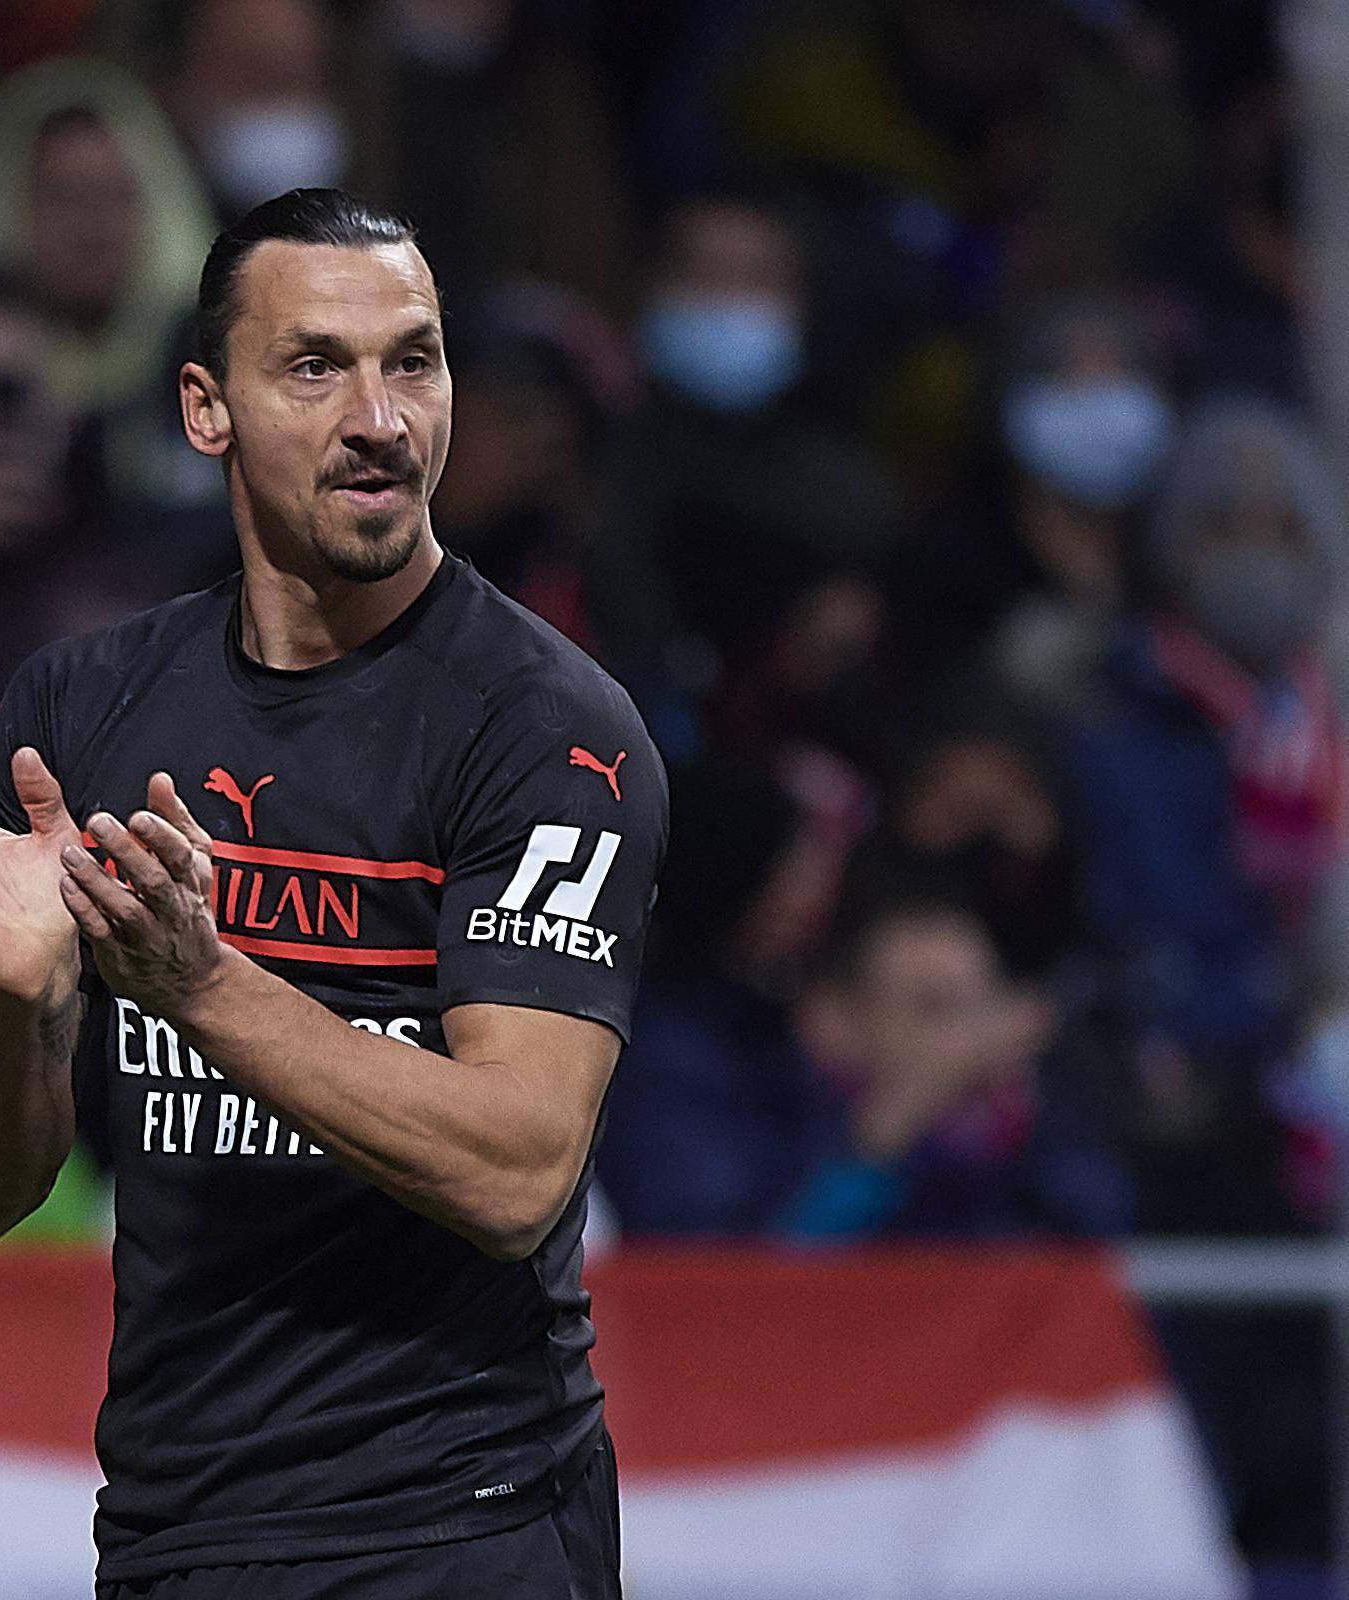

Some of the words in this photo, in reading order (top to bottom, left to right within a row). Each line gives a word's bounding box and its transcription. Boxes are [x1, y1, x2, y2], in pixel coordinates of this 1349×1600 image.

[211, 868, 360, 940] ILAN
[466, 908, 619, 968] BitMEX
[143, 1090, 203, 1154] FLY
